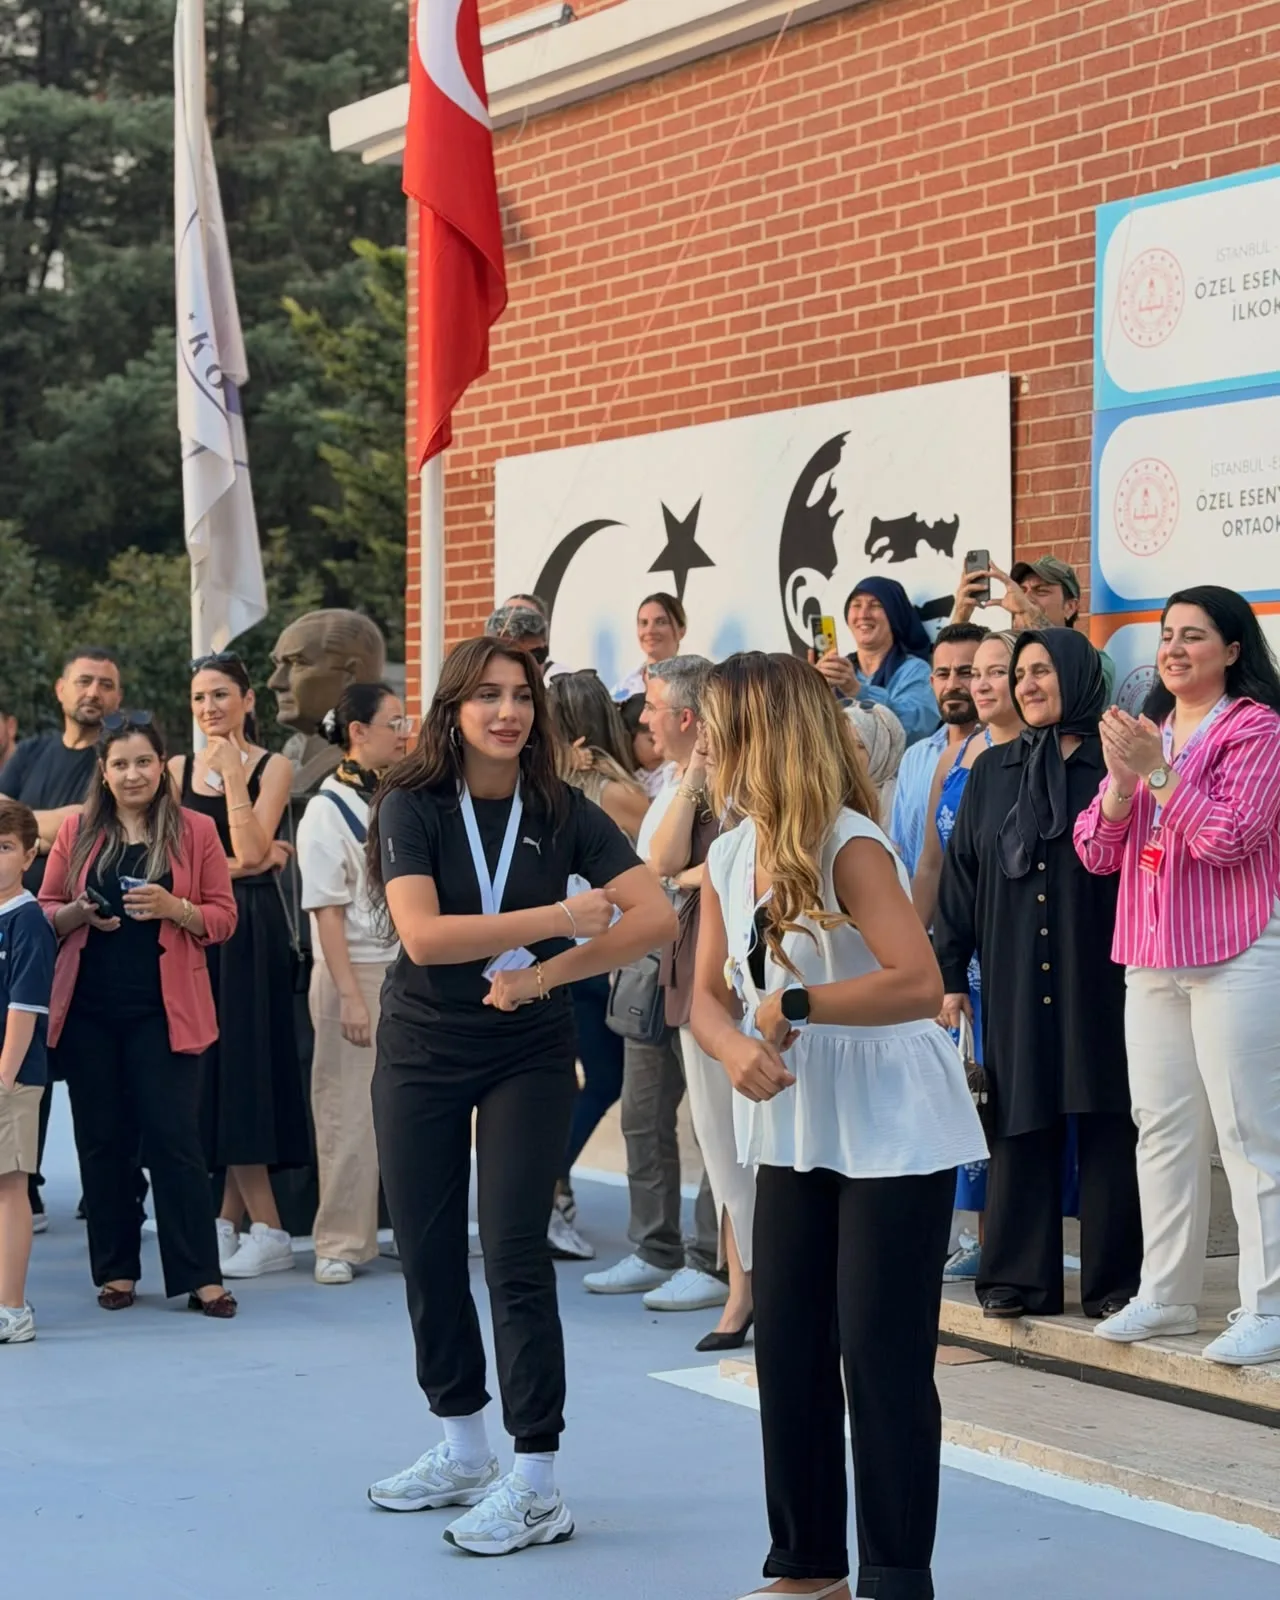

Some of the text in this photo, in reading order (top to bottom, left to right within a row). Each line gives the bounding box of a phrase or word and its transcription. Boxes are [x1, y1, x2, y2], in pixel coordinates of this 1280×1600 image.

[1195, 276, 1236, 299] ÖZEL
[1196, 486, 1280, 512] ÖZEL ESEN
